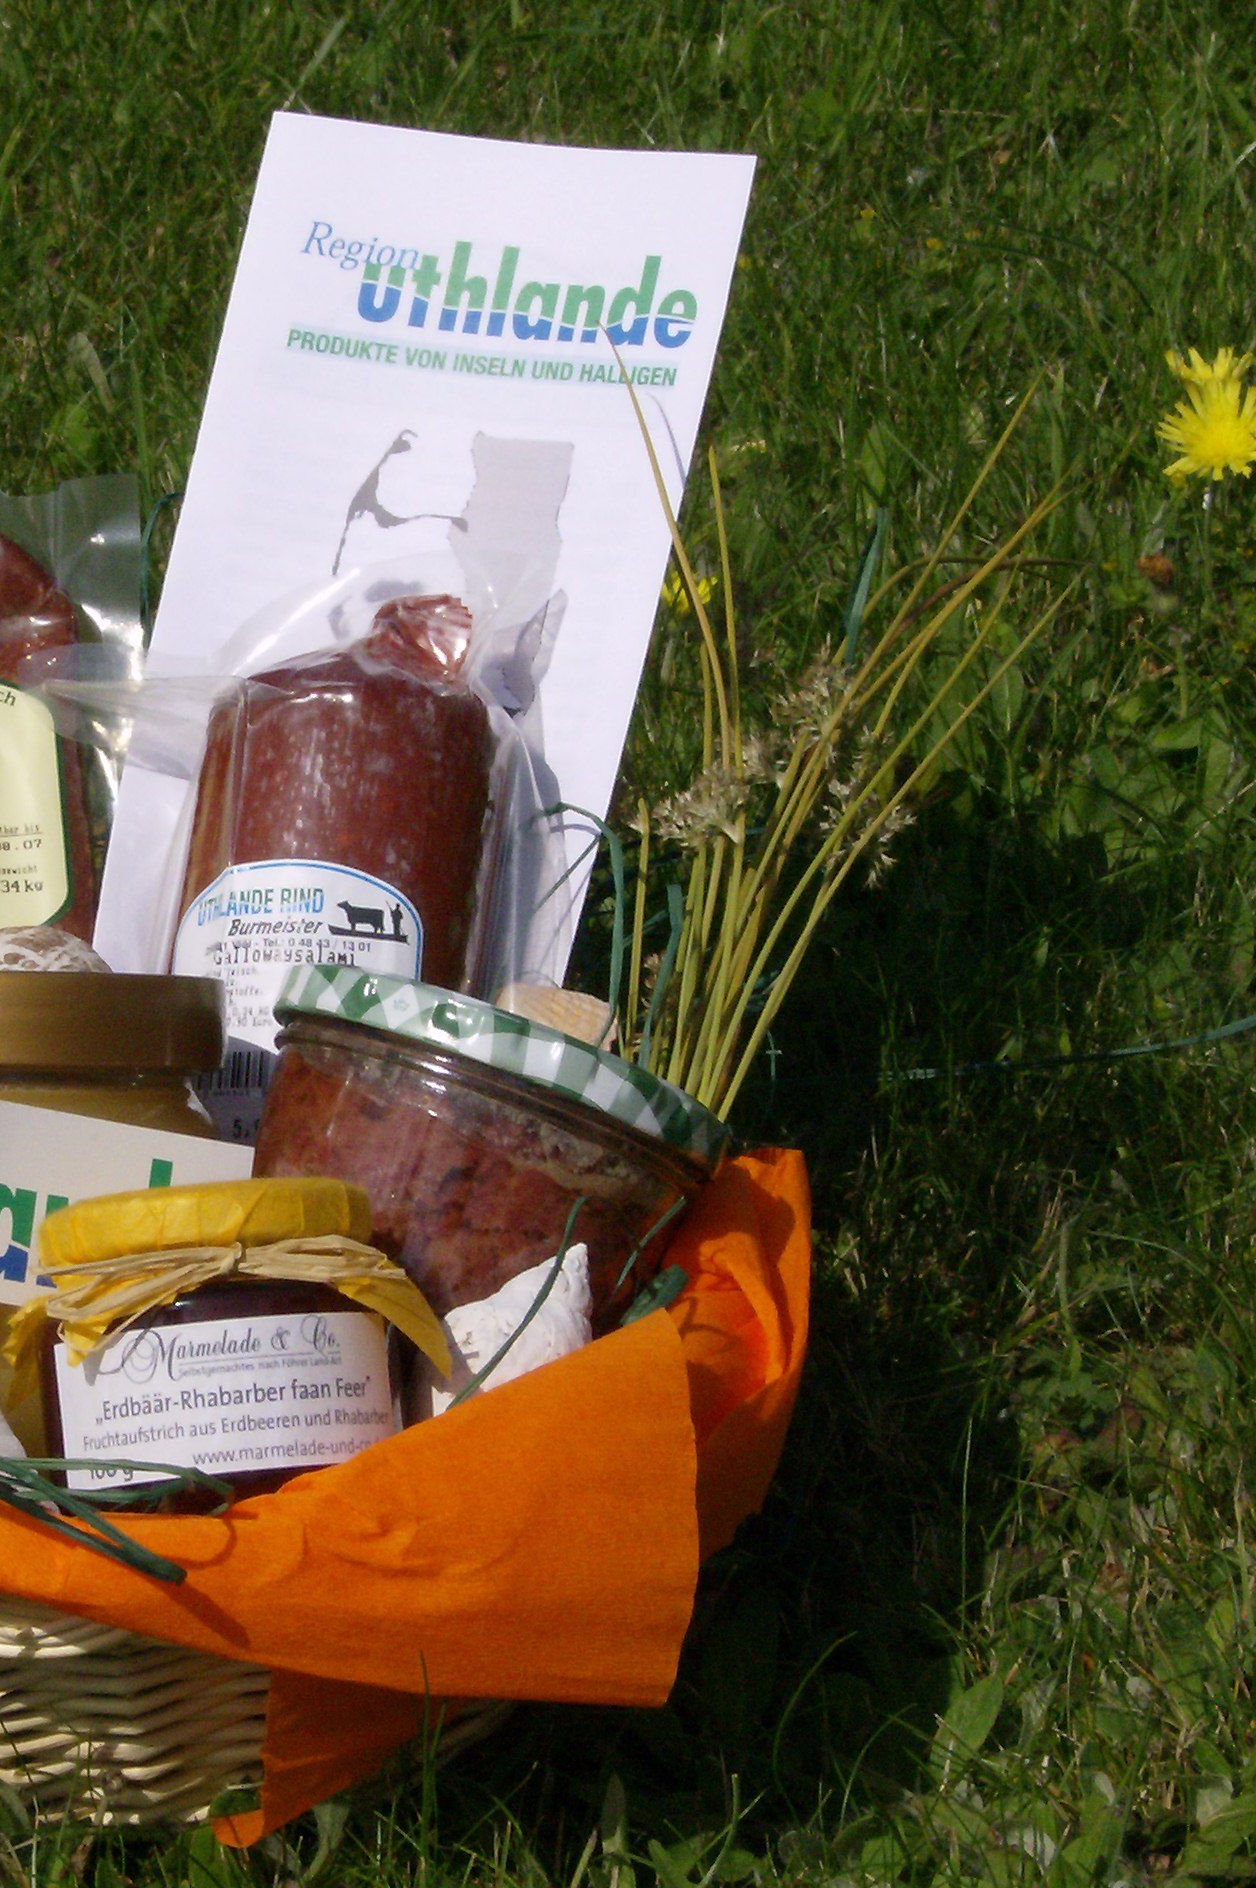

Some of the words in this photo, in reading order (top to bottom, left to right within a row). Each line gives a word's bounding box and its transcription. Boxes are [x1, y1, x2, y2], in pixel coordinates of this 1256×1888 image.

[301, 221, 419, 270] Region
[286, 328, 399, 364] PRODUKTE
[406, 346, 445, 371] VON
[453, 353, 526, 379] INSELN
[531, 360, 574, 382] UND
[579, 363, 678, 387] HALLIGEN
[280, 888, 325, 914] RIND
[228, 918, 323, 937] Burmeister
[95, 1326, 261, 1384] Marmelade
[271, 1327, 291, 1350] &
[291, 1379, 331, 1400] faan
[83, 1423, 185, 1451] Fruchtaufstrich
[190, 1422, 217, 1437] aus
[221, 1413, 300, 1434] Erdbeeren
[305, 1410, 330, 1427] und
[335, 1408, 389, 1425] Rhabarber
